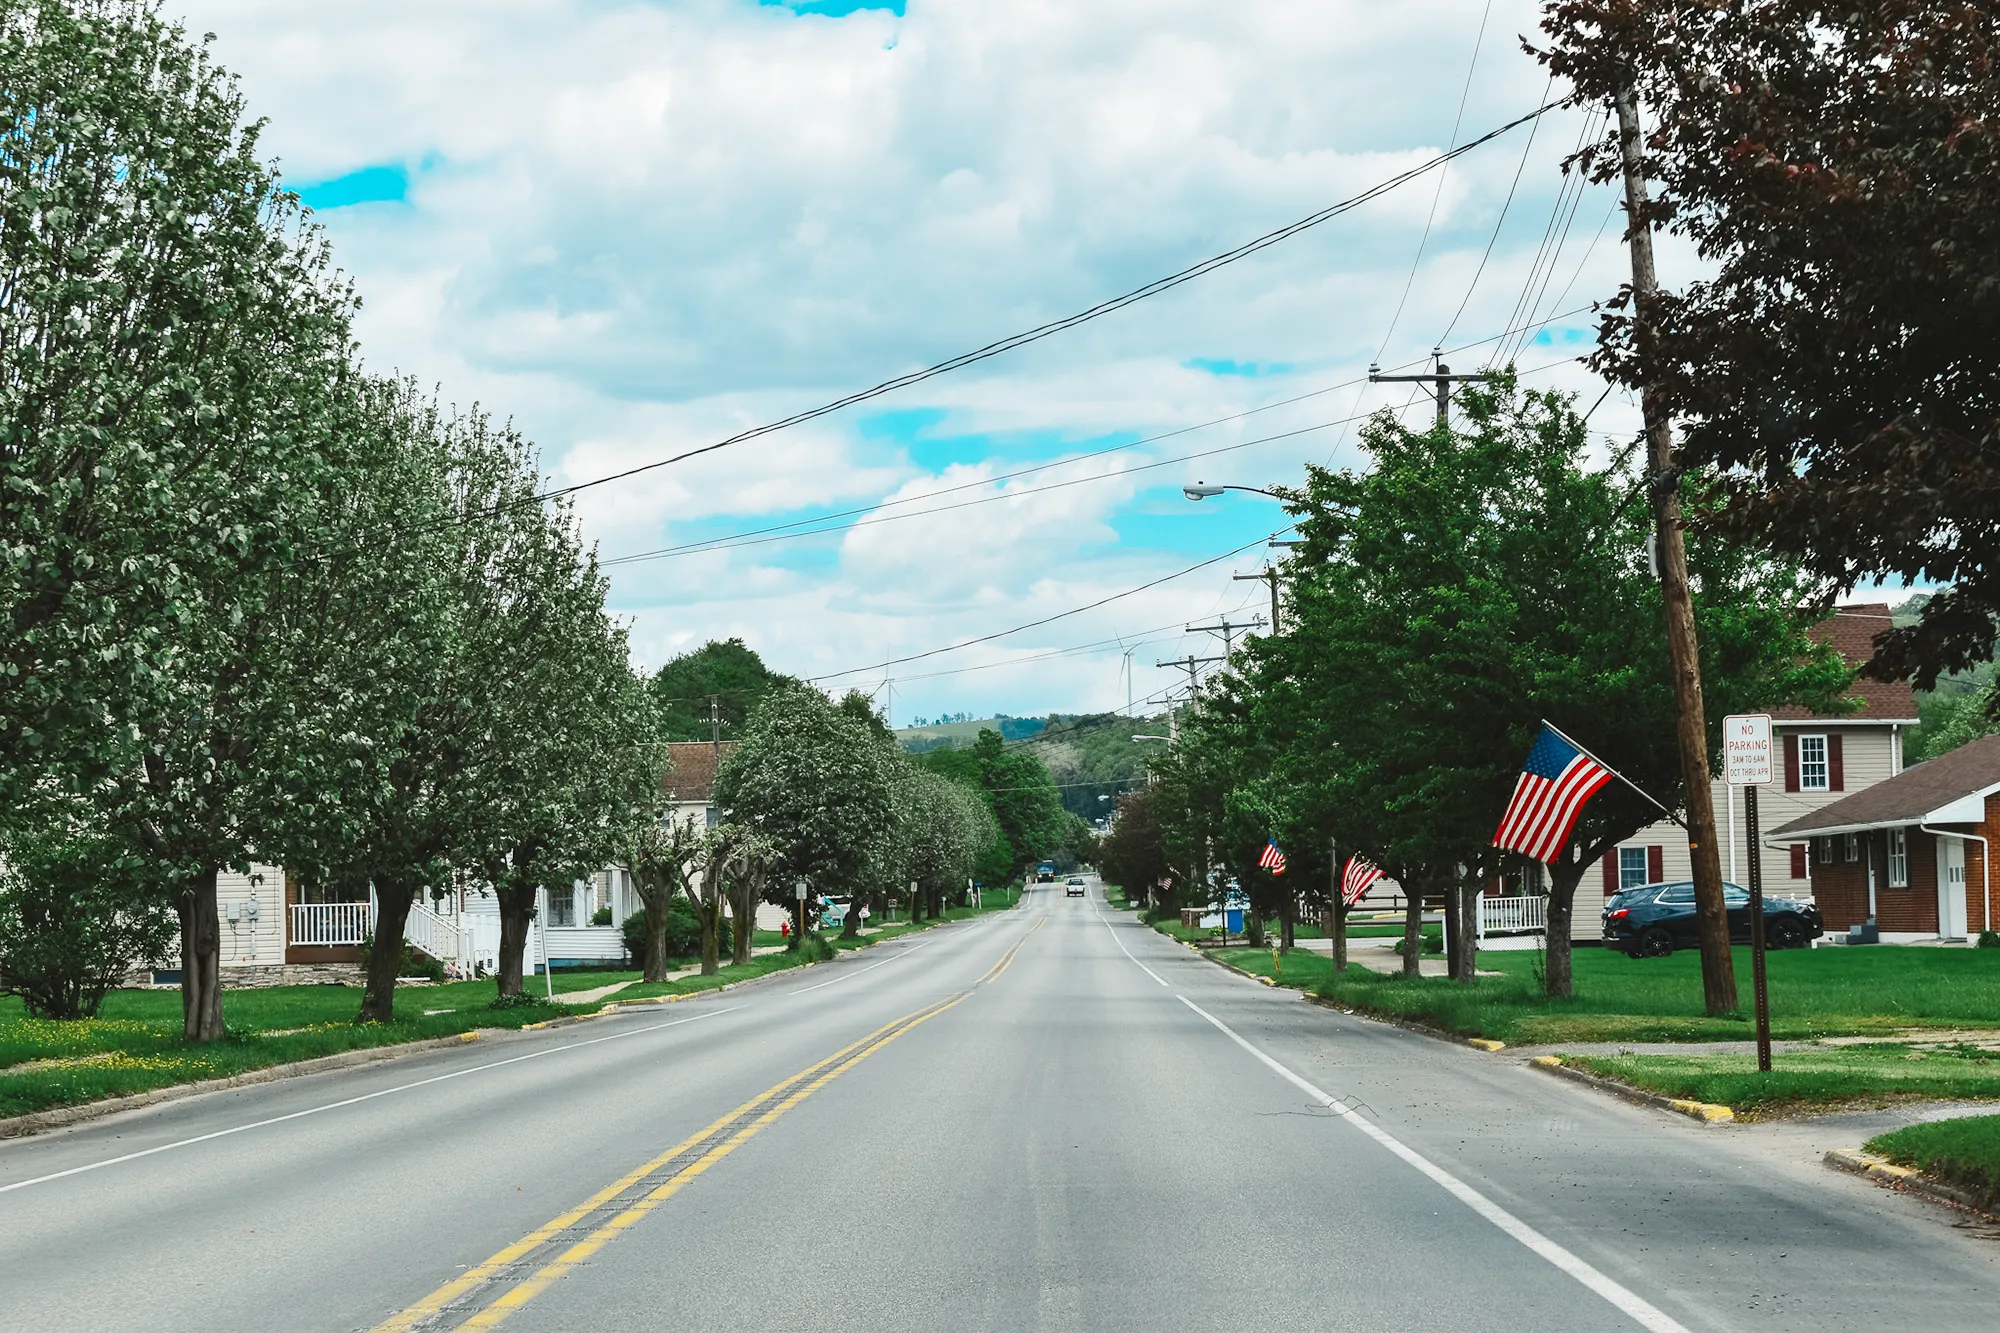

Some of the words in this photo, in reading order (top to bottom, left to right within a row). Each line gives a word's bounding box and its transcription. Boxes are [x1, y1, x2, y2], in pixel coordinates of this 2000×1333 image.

[1741, 725, 1754, 735] NO
[1729, 740, 1767, 750] PARKING
[1732, 756, 1744, 764] 3AM
[1745, 755, 1752, 763] TO
[1753, 755, 1765, 763] 6AM
[1730, 768, 1740, 776] OCT
[1742, 768, 1756, 776] THRU
[1757, 767, 1768, 776] APR
